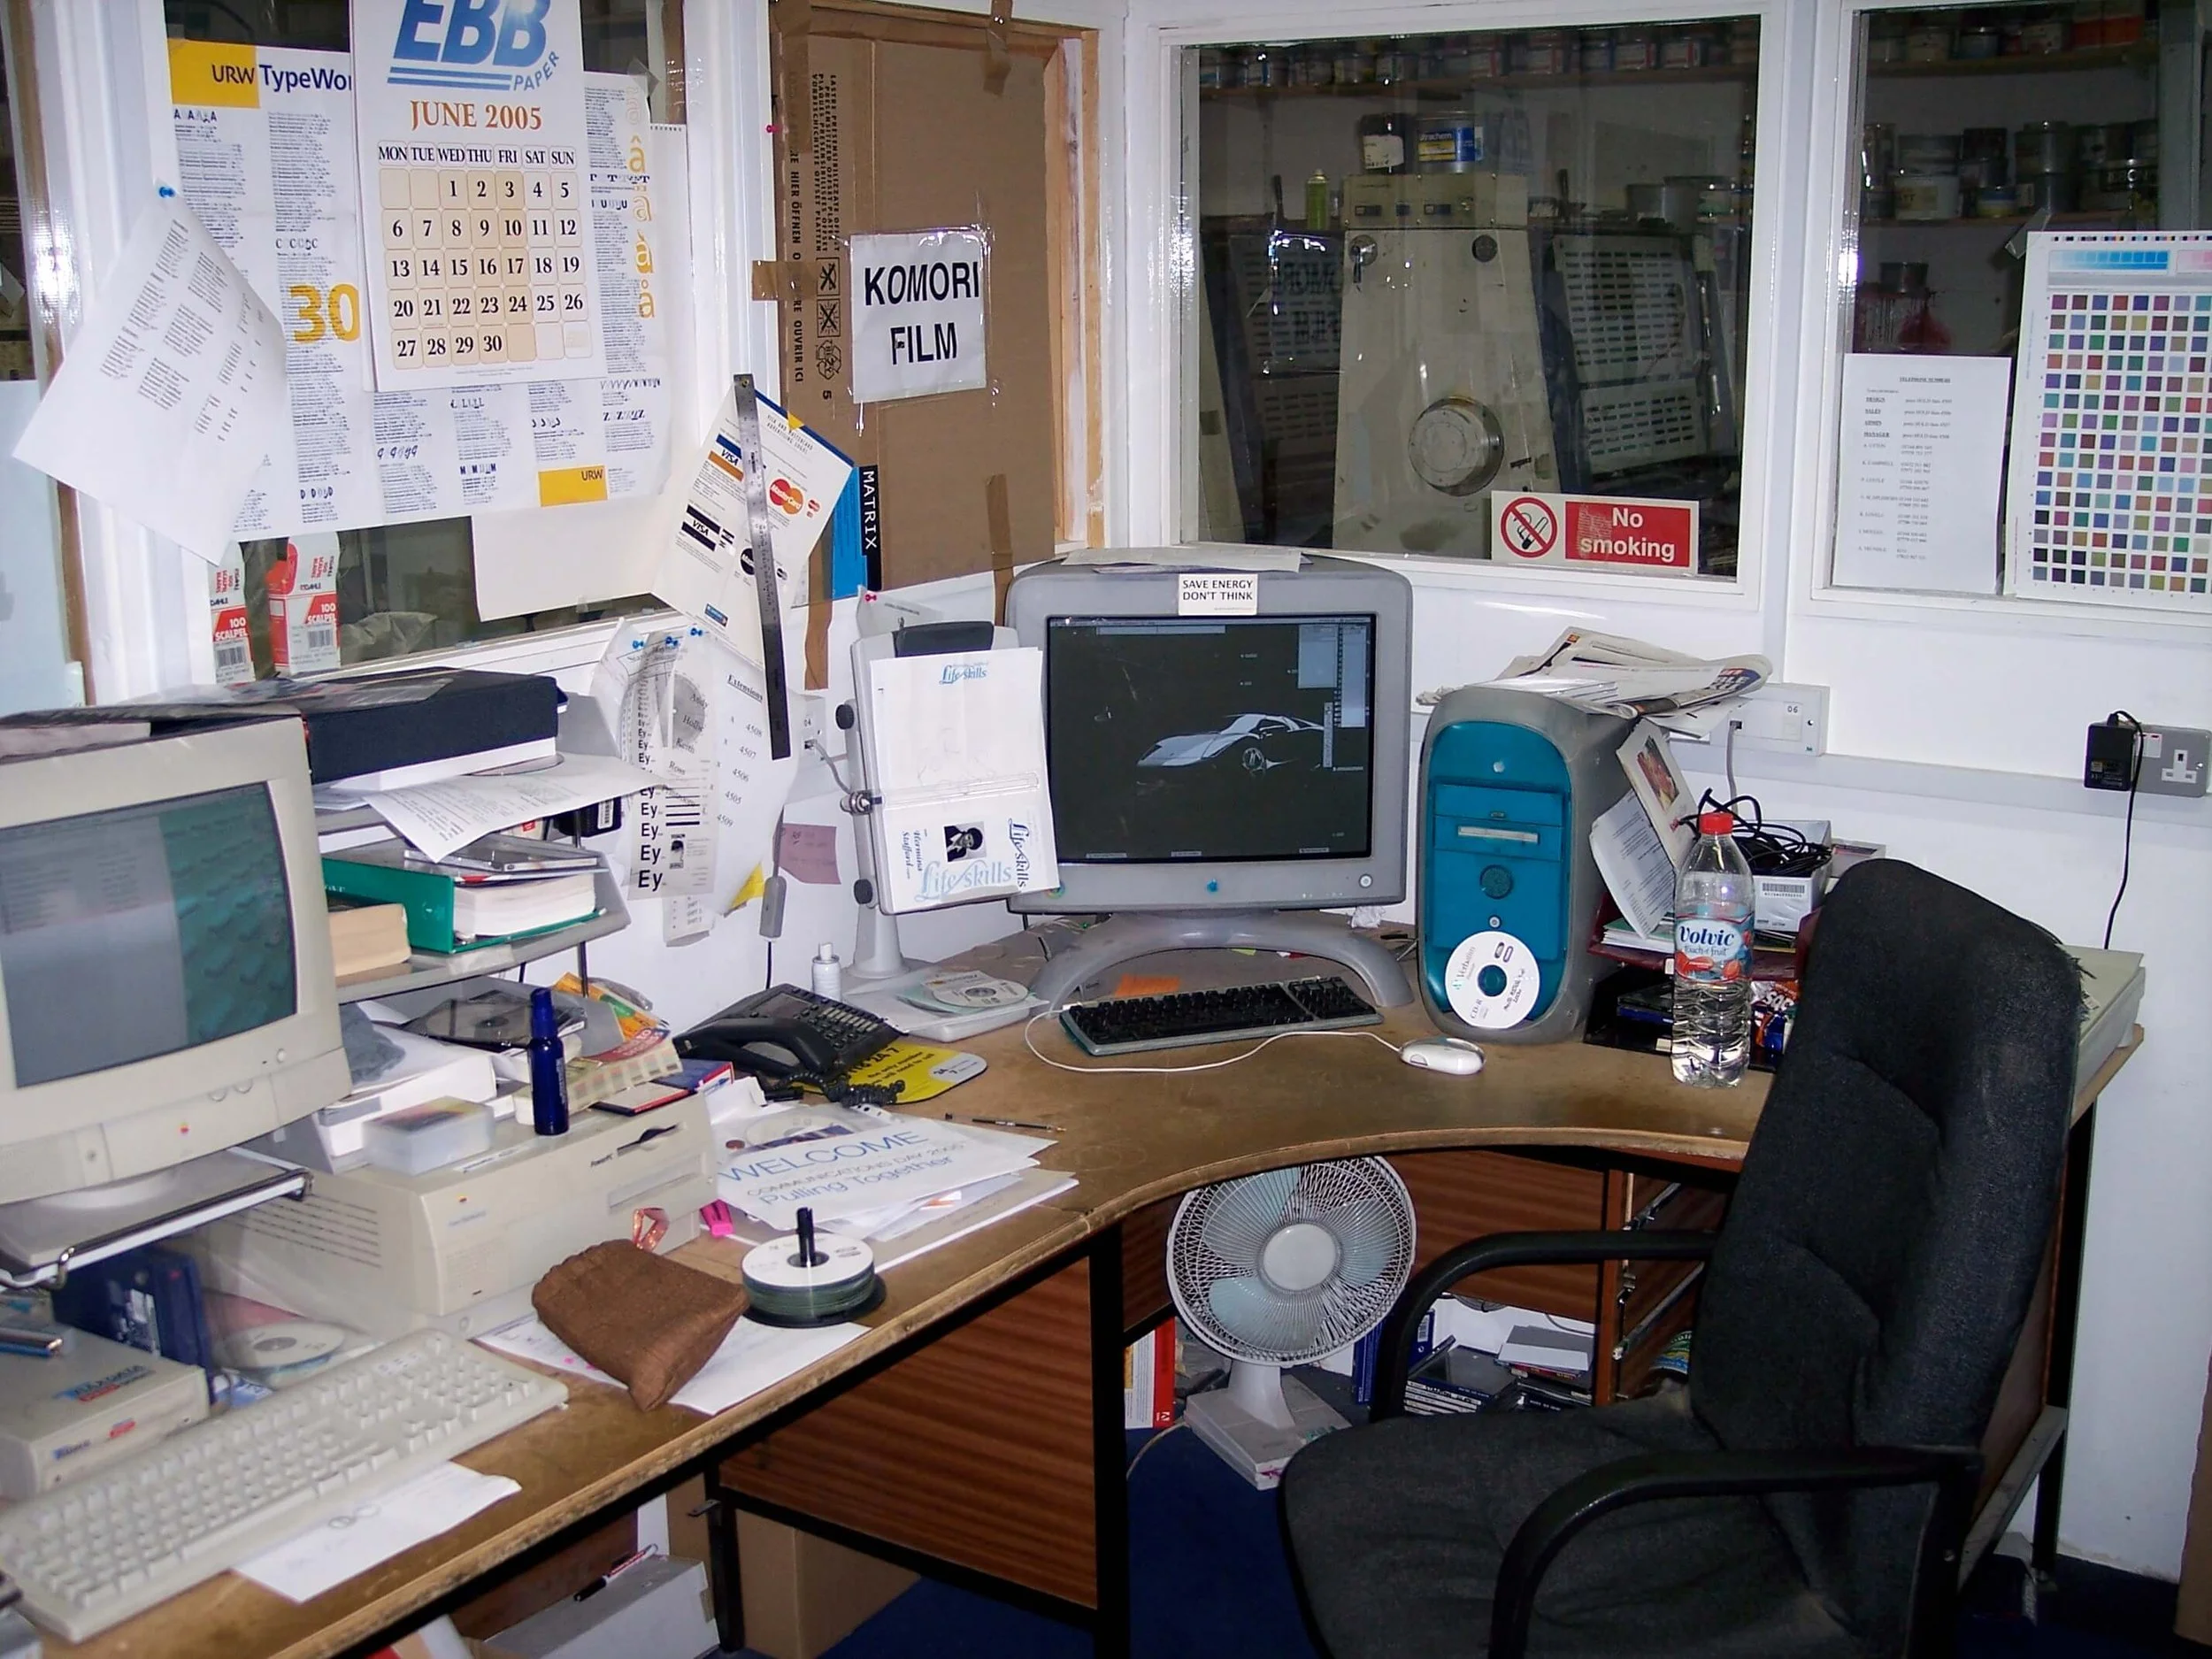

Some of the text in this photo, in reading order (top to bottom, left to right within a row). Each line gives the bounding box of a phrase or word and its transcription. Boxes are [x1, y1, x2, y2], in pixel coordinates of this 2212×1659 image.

[394, 0, 546, 67] EBB
[211, 65, 255, 85] URW
[513, 50, 561, 92] PAPER
[410, 100, 542, 132] JUNE 2005
[378, 146, 575, 165] MON TUE WED THU FRI SAT SUN
[450, 180, 569, 198] 1 2 3 4 5
[790, 171, 801, 197] HIER
[392, 219, 576, 237] 6 7 8 9 10 11 12
[792, 202, 803, 243] ÖFFNEN
[392, 256, 580, 277] 13 14 15 16 17 18 19
[864, 261, 980, 307] KOMORI
[289, 283, 361, 344] 30
[394, 294, 583, 317] 20 21 22 23 24 25 26
[397, 335, 503, 357] 27 28 29 30
[793, 320, 804, 382] OUVRIR ICI
[890, 322, 957, 365] FILM
[822, 389, 833, 400] 5
[720, 449, 739, 466] VISA
[581, 470, 603, 480] URW
[771, 485, 803, 511] MasterCard
[862, 470, 879, 550] MATRIX
[1612, 507, 1644, 528] No
[691, 519, 710, 536] VISA
[1580, 536, 1676, 564] smoking
[1183, 580, 1253, 589] SAVE ENERGY
[1183, 591, 1253, 601] DON'T THINK
[307, 612, 338, 625] SCALPEL
[321, 603, 336, 613] 100
[229, 617, 247, 628] 100
[215, 627, 248, 641] SCALPEL
[727, 673, 764, 703] Extensions
[690, 693, 709, 709] Andy
[675, 737, 695, 754] Keith
[639, 752, 651, 765] Ey
[669, 760, 687, 775] Ross
[641, 803, 657, 818] Ey
[641, 823, 659, 841] Ey
[641, 845, 661, 865] Ey
[638, 870, 664, 892] Ey
[1680, 926, 1735, 947] Volvic
[718, 1130, 929, 1182] WELCOME
[747, 1160, 892, 1196] COMMUNICATIONS
[759, 1156, 956, 1206] Pulling Together
